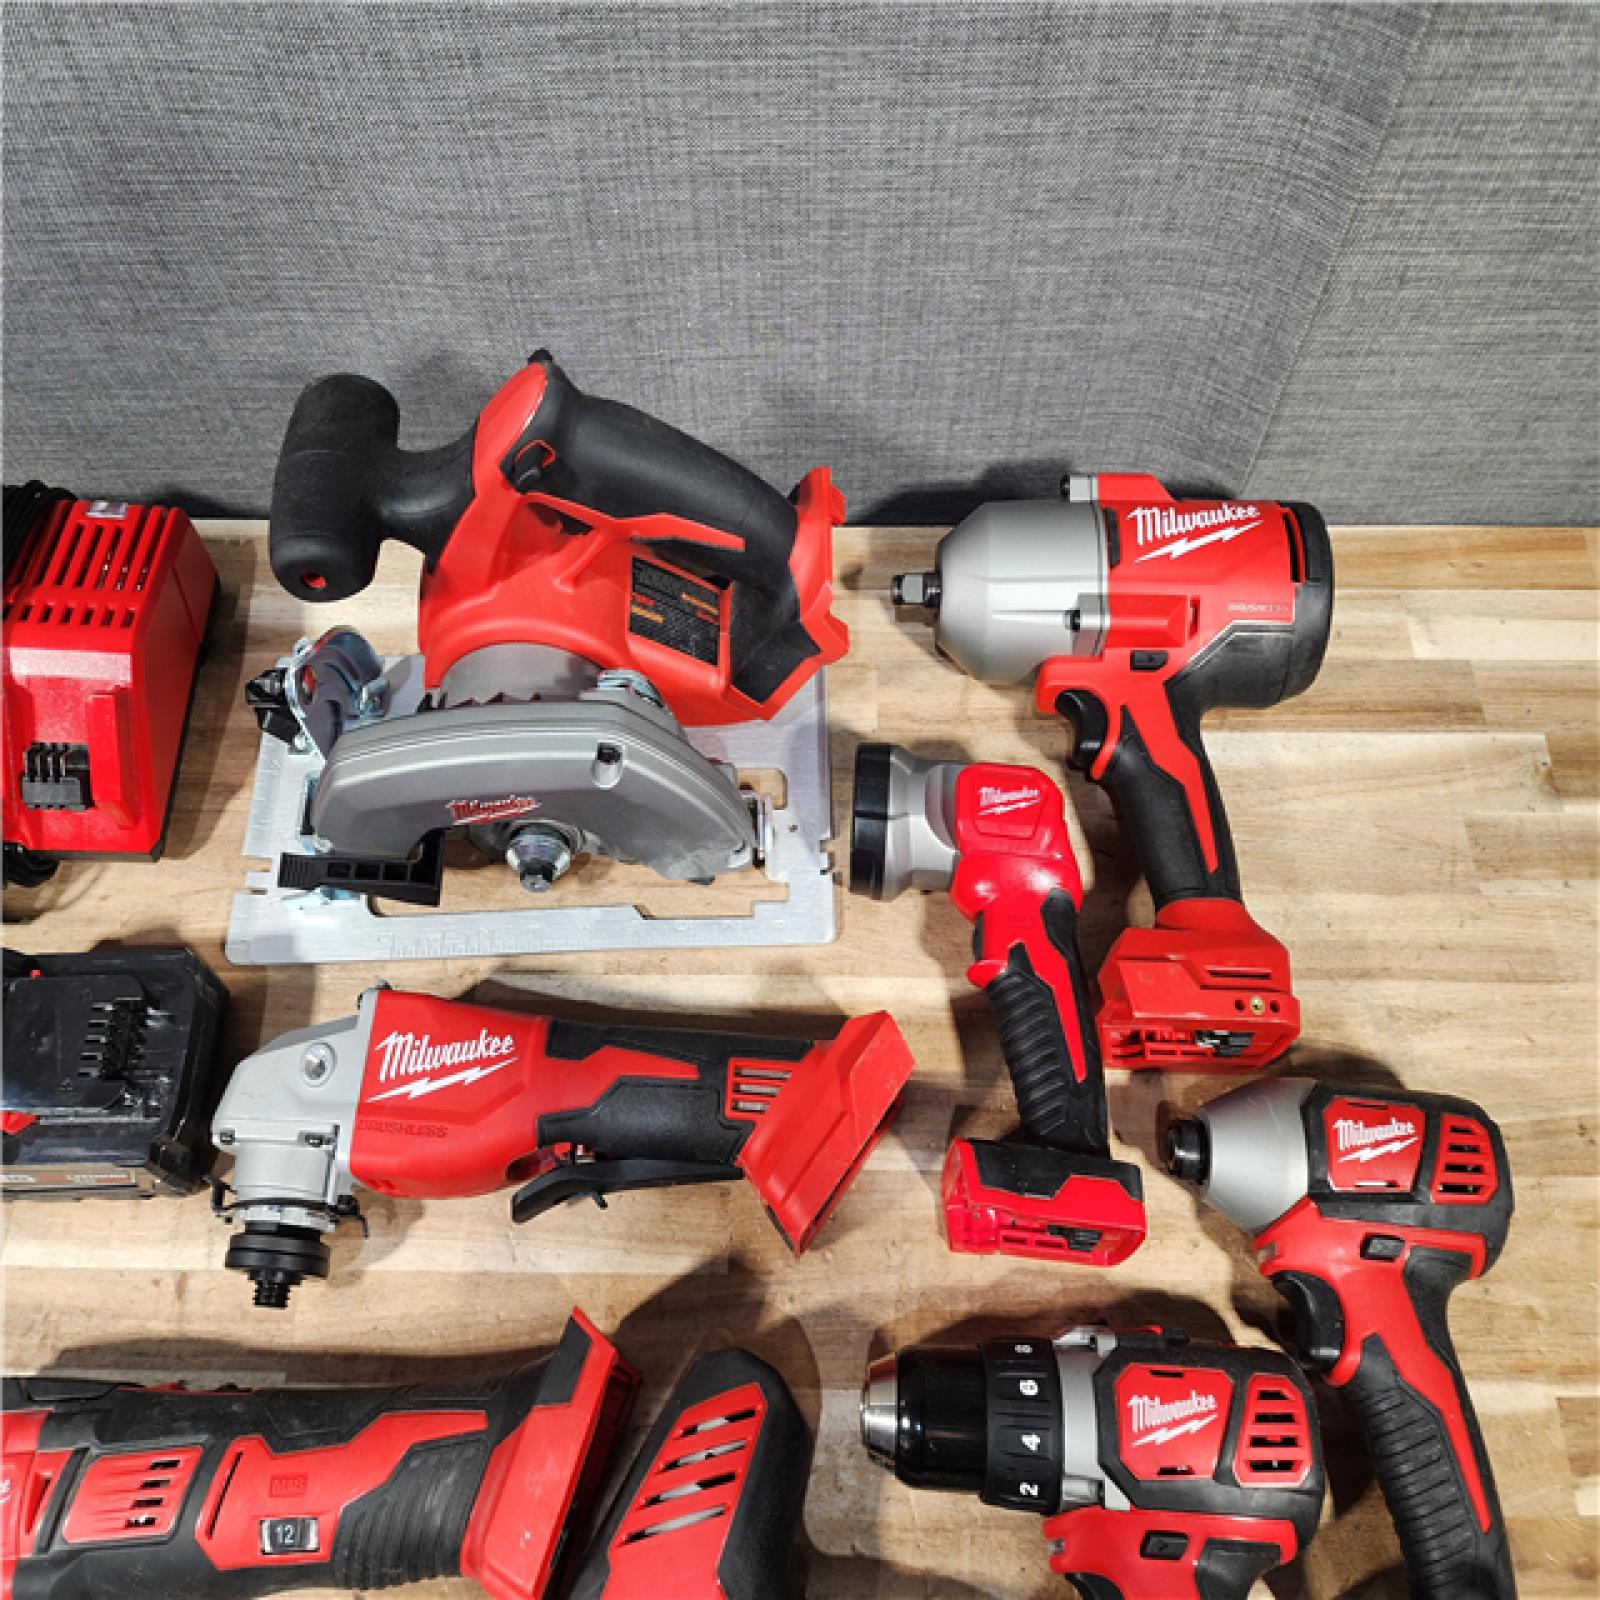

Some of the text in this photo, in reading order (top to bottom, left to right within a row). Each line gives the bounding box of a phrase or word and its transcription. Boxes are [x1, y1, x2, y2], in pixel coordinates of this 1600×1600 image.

[1126, 502, 1261, 546] Milwaukee
[978, 785, 1040, 806] Milwaukee
[375, 1028, 516, 1083] Milwaukee
[1332, 1117, 1415, 1151] Milwaukee
[1127, 1389, 1217, 1434] Milwaukee
[1020, 1433, 1041, 1452] 4
[1019, 1482, 1039, 1496] 2
[275, 1524, 296, 1546] 12
